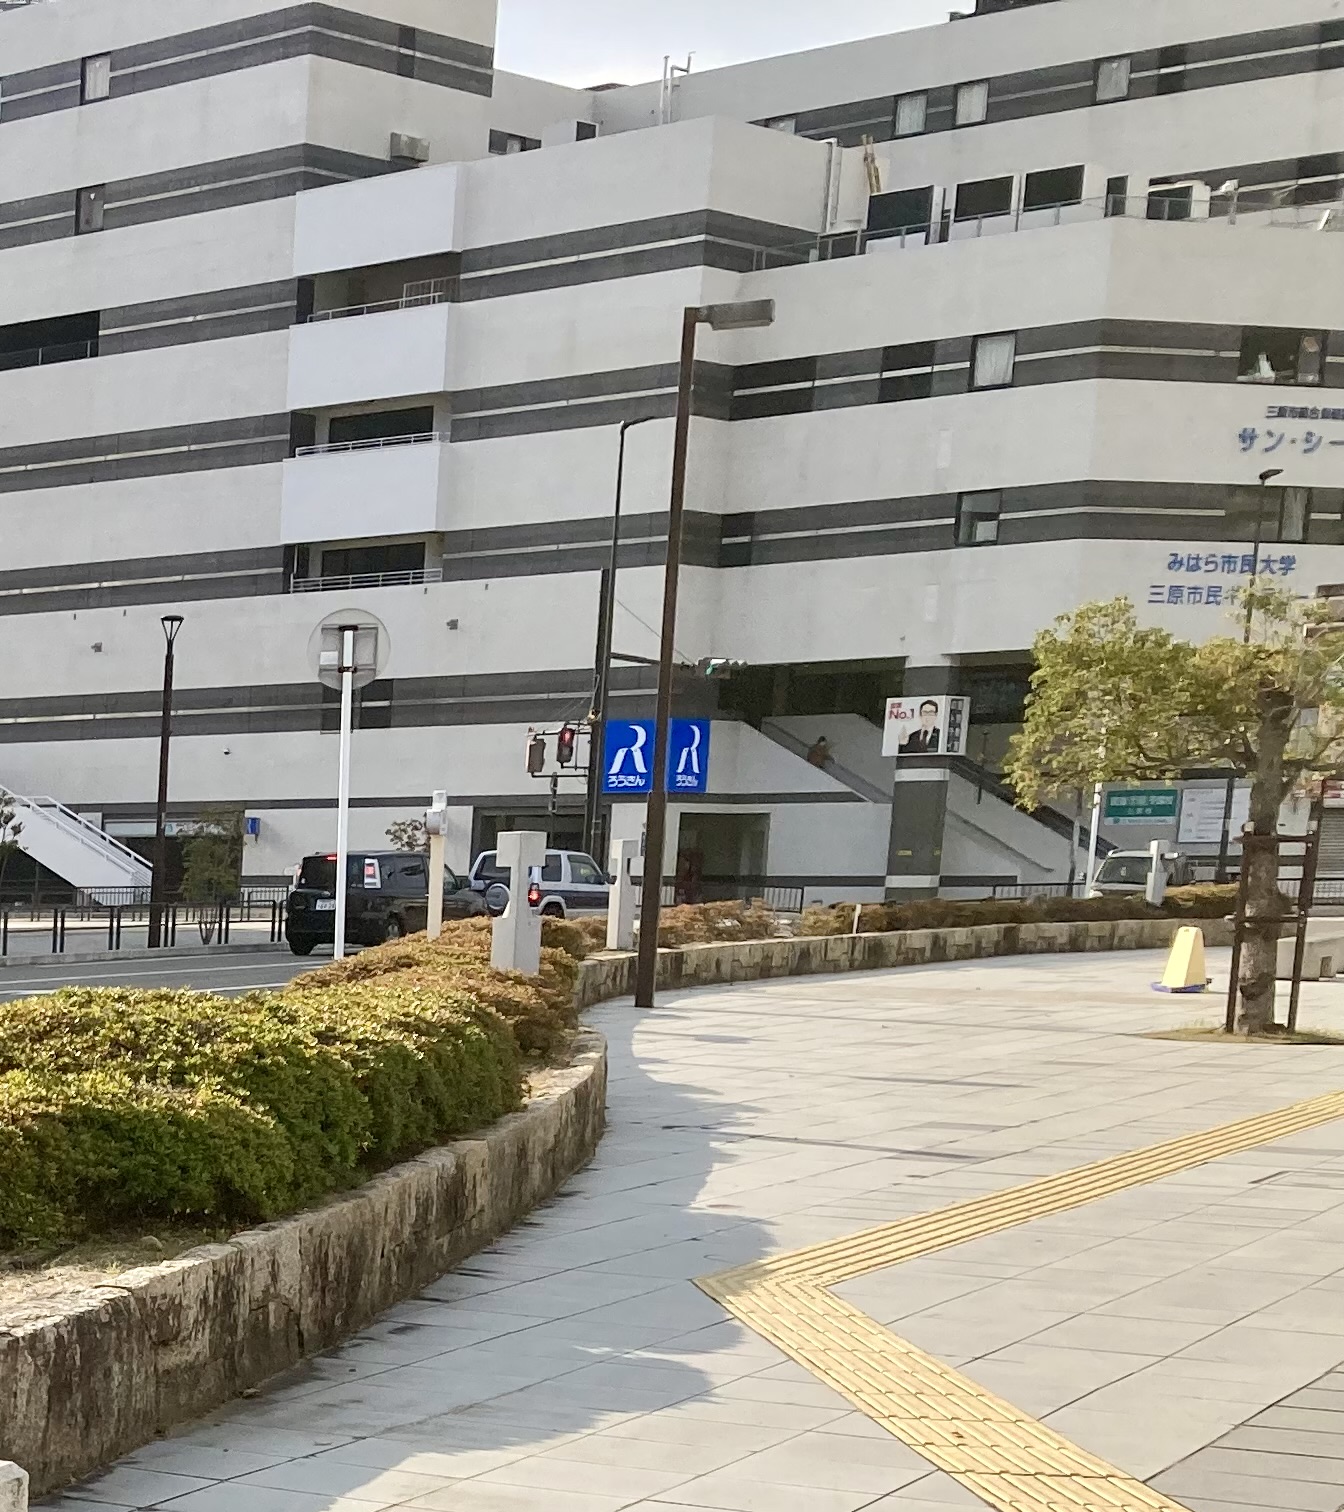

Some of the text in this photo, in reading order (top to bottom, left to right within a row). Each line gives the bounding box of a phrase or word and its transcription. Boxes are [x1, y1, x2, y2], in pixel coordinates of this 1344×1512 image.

[1167, 552, 1296, 575] みはら市民大学
[888, 708, 915, 720] No.1
[607, 774, 646, 788] ろうきん
